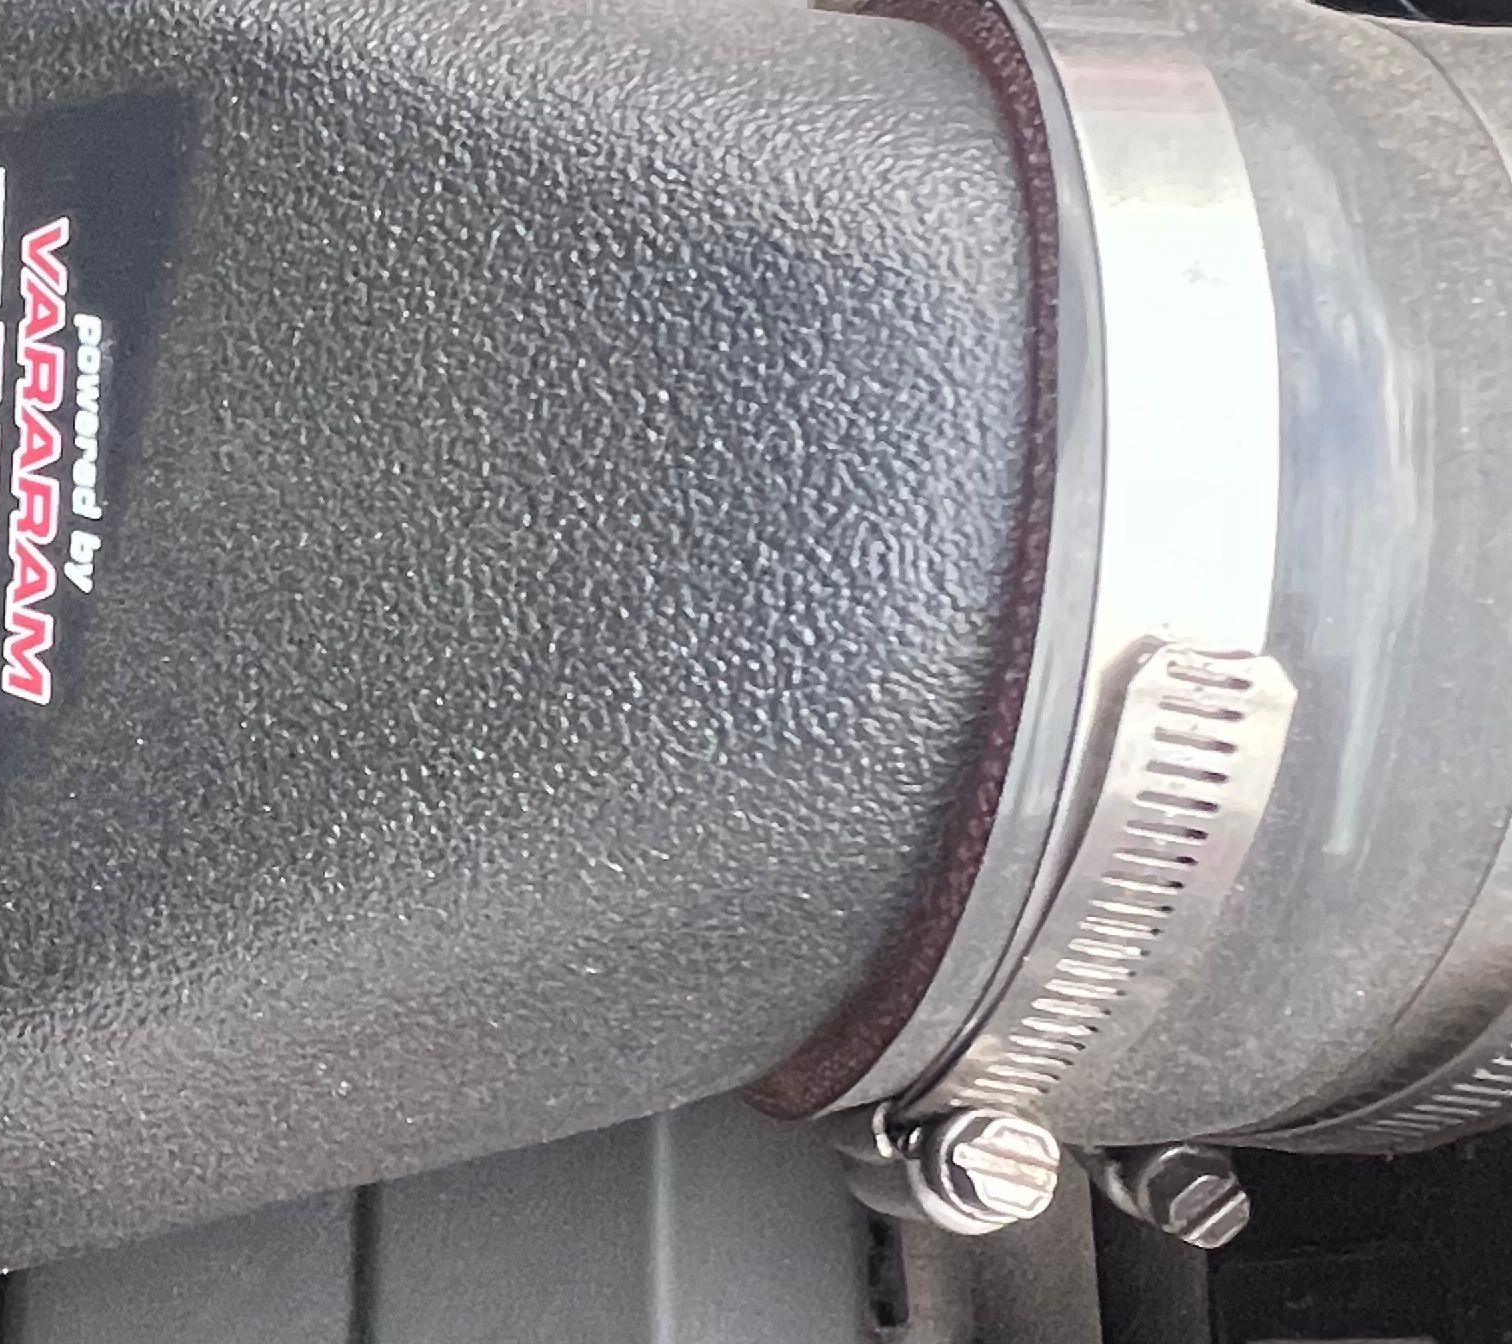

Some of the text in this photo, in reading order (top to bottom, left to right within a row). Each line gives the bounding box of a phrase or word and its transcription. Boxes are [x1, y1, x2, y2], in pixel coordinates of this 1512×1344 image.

[2, 217, 70, 705] VARARAM
[65, 314, 102, 594] powered by
